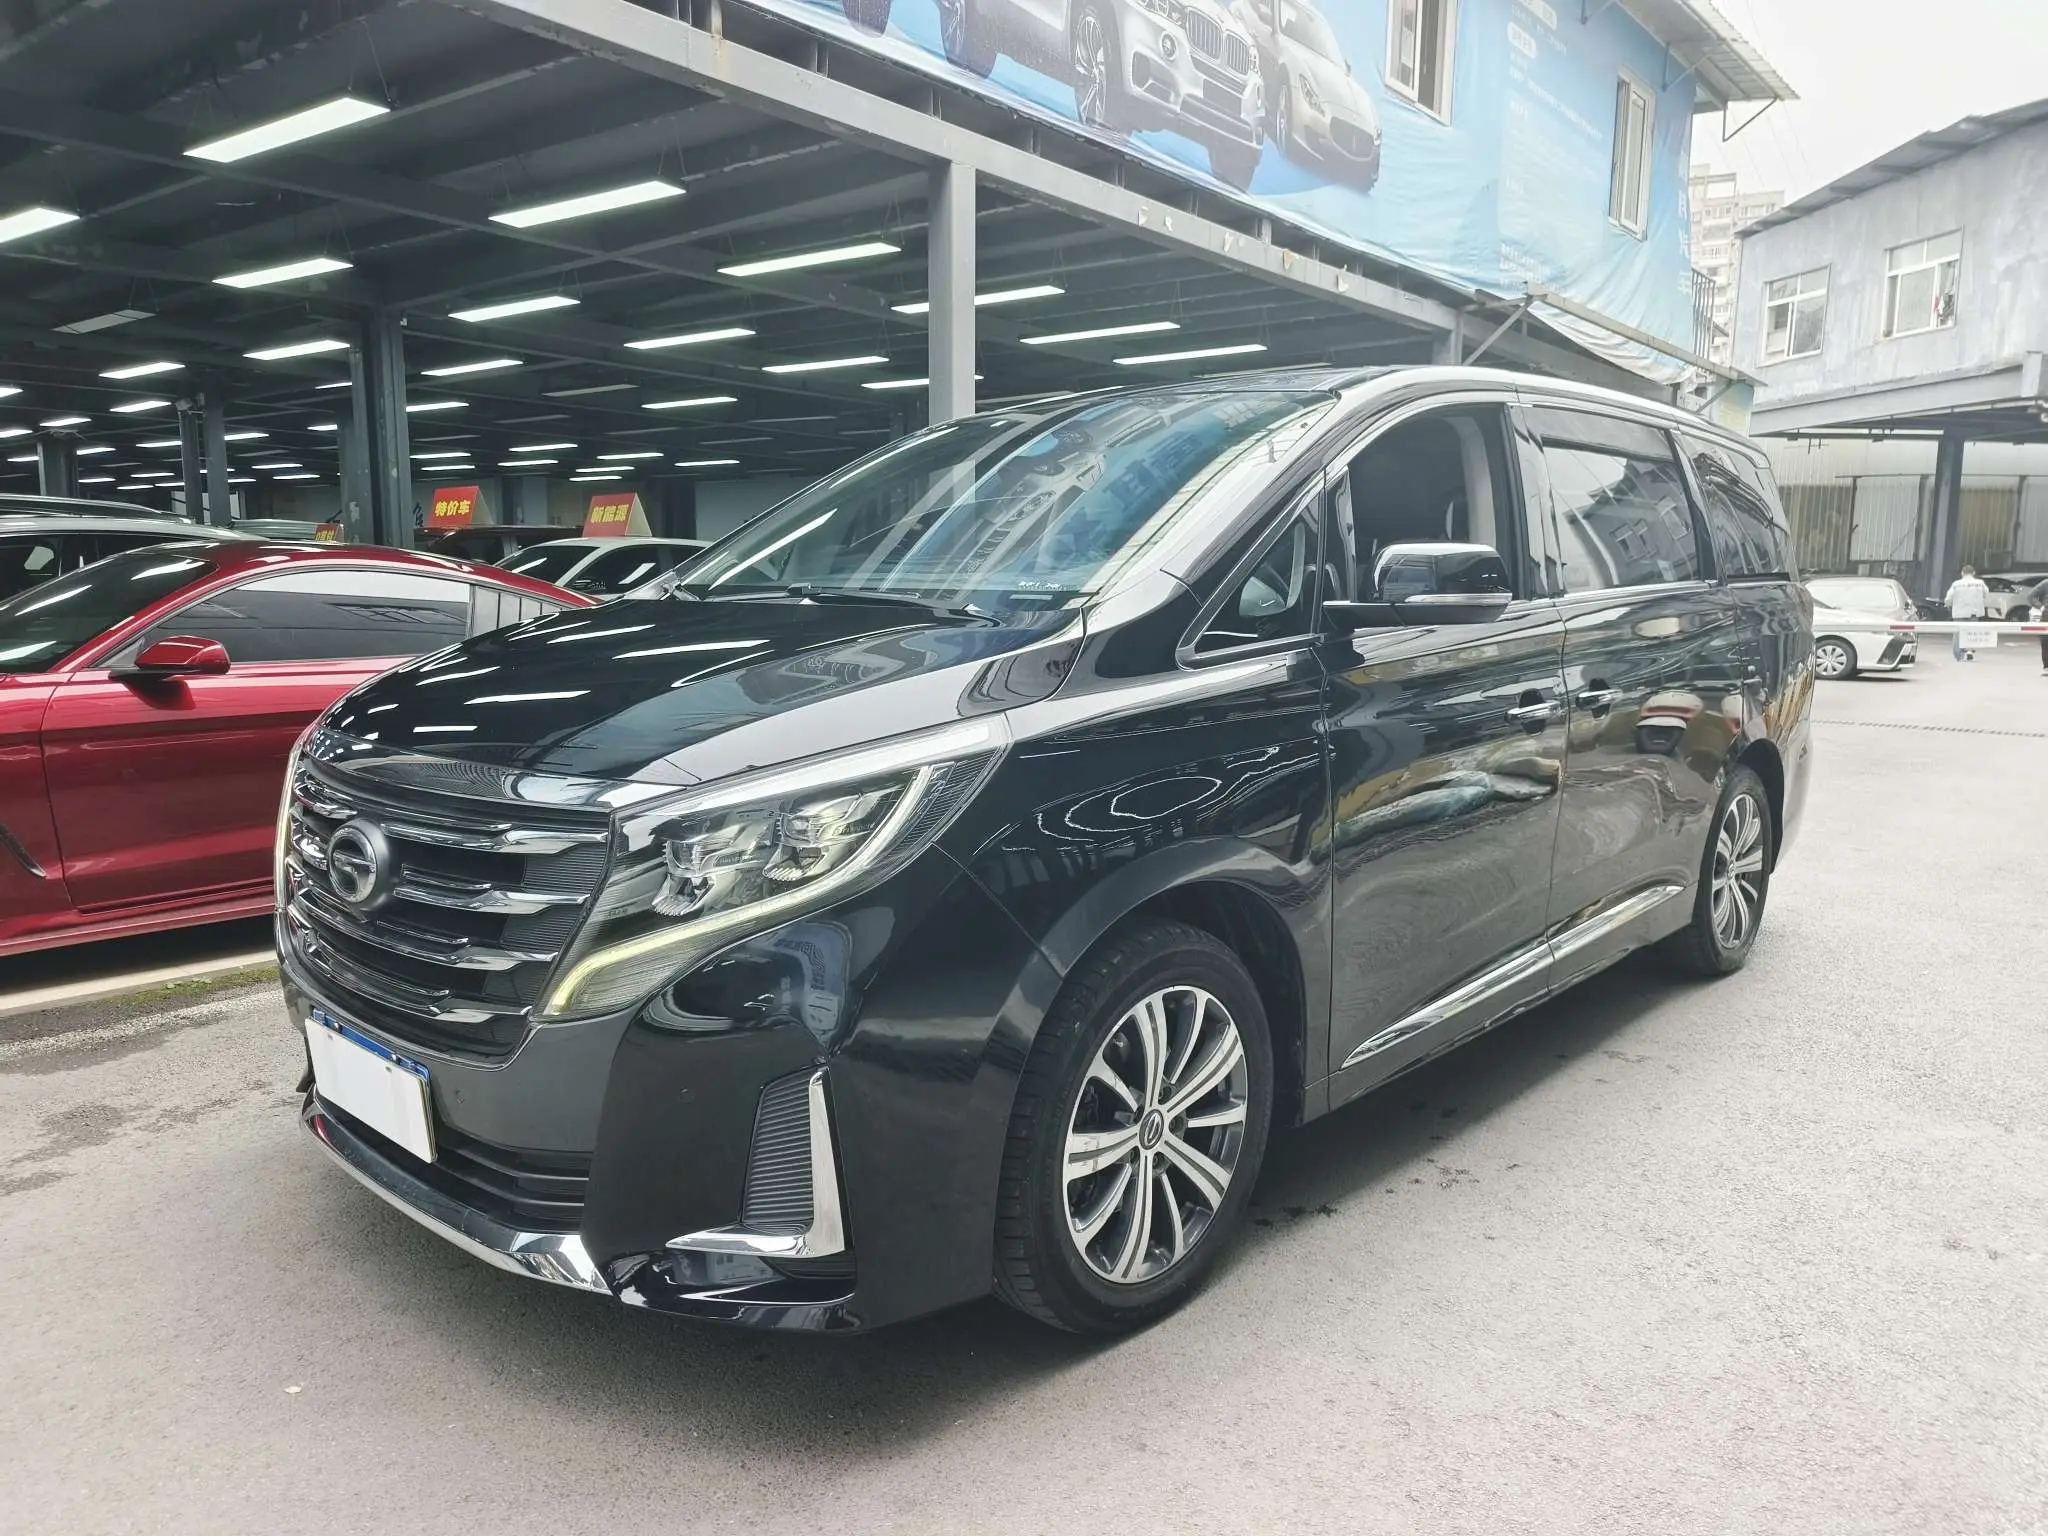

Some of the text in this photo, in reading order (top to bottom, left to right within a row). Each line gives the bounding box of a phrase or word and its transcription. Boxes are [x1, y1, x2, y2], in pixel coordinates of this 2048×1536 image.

[435, 498, 471, 517] 特价车
[591, 504, 629, 523] 新能源
